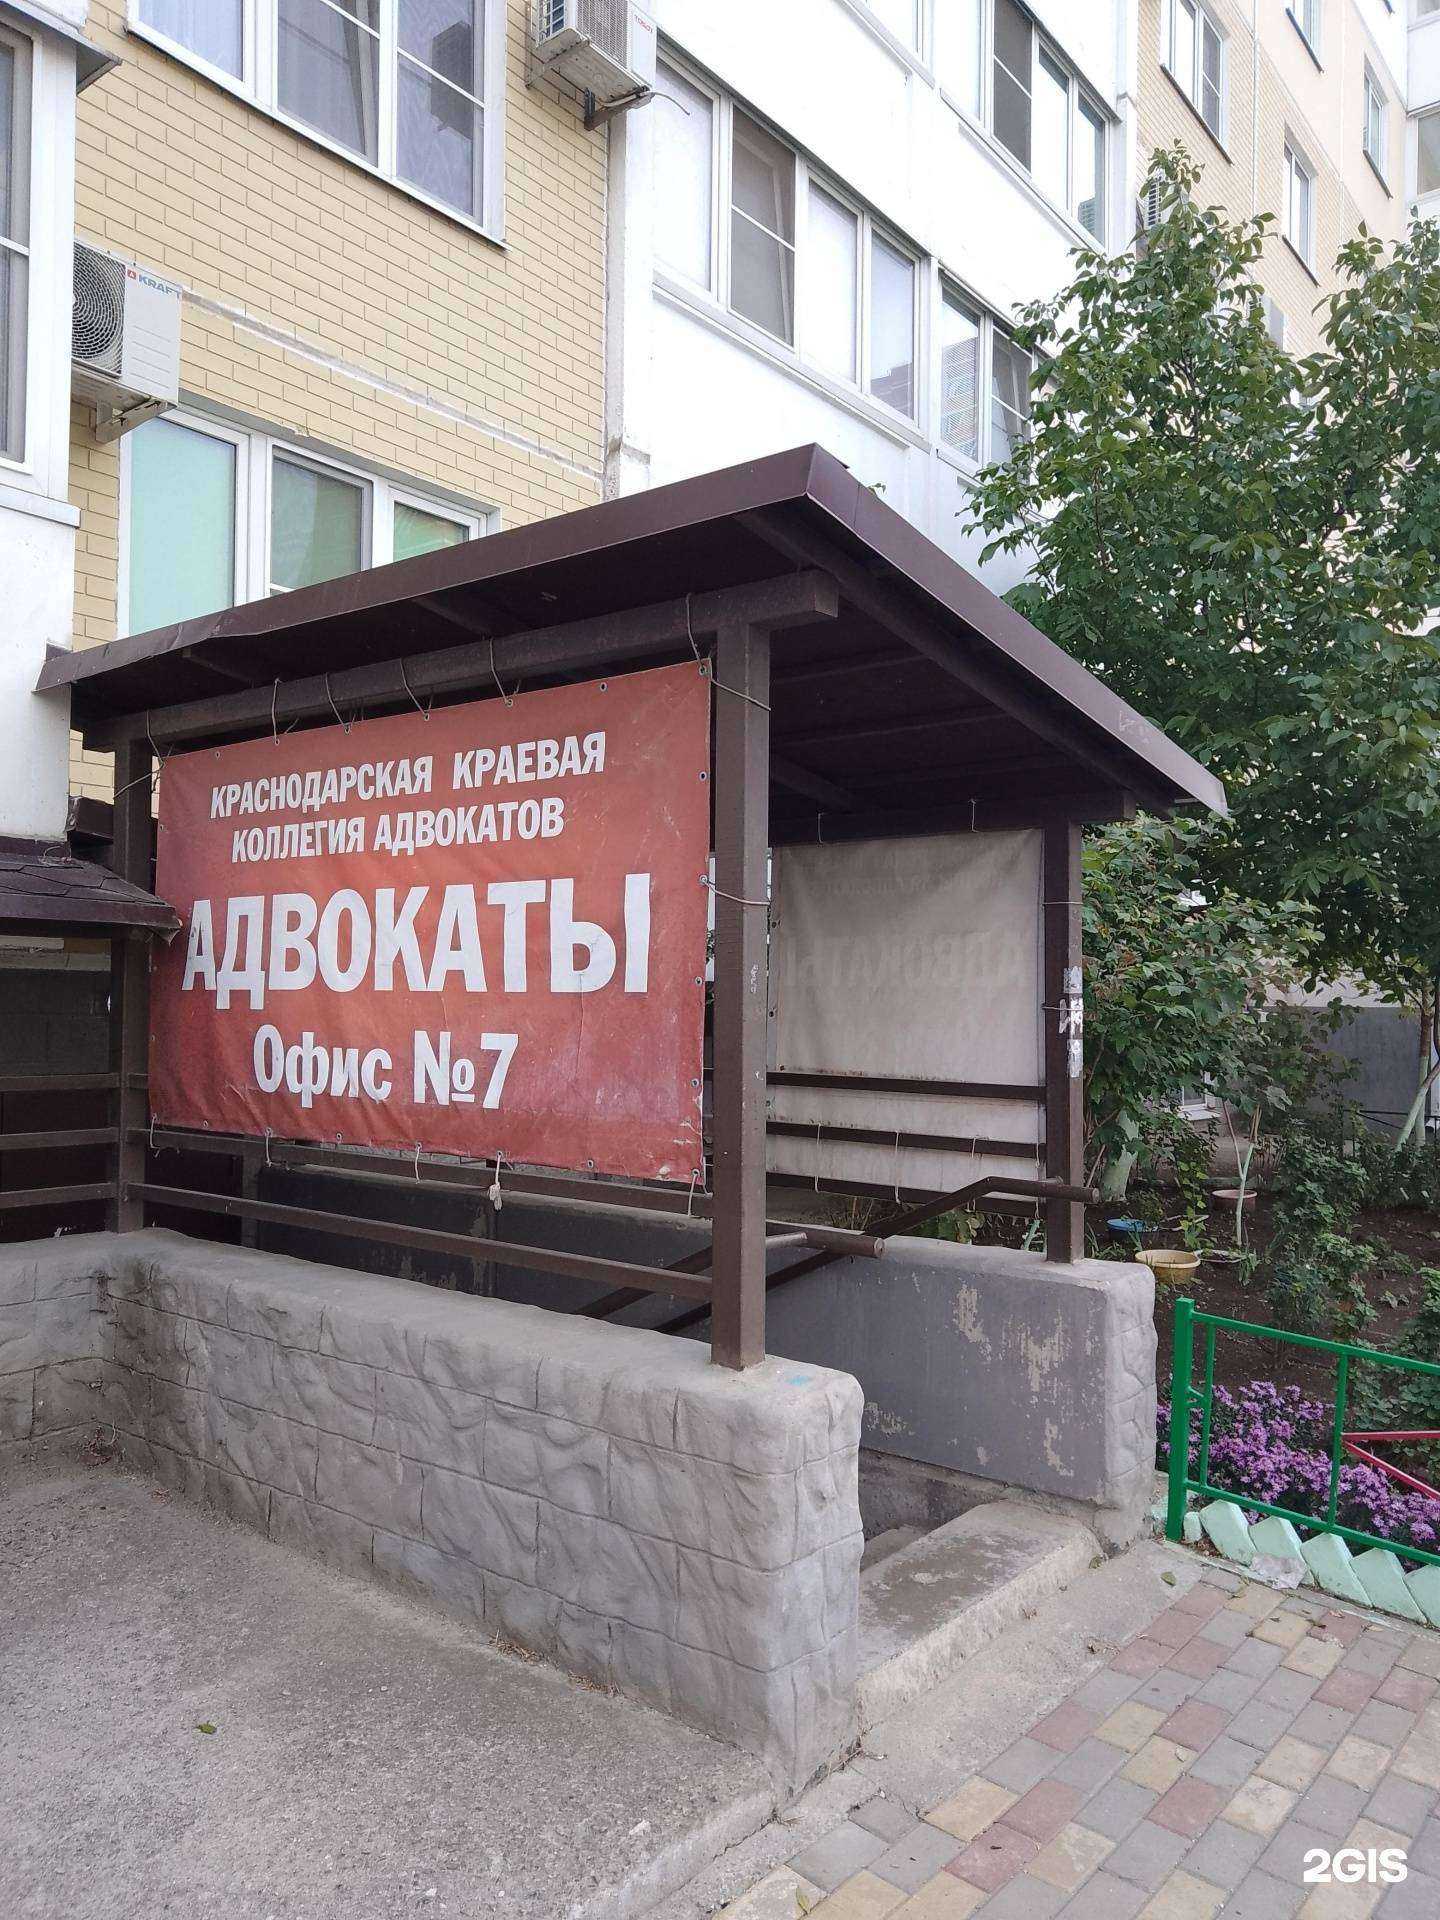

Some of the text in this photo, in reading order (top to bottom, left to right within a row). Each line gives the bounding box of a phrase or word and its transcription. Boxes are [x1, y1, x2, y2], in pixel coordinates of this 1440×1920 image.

[138, 273, 182, 300] KRAFT
[210, 731, 606, 819] КРАСНОДАРСКАЯ КРАЕВАЯ
[231, 797, 565, 864] КОЛЛЕГИЯ АДВОКАТОВ
[182, 873, 651, 1011] АДВОКАТЫ
[253, 1023, 519, 1110] Офис №7
